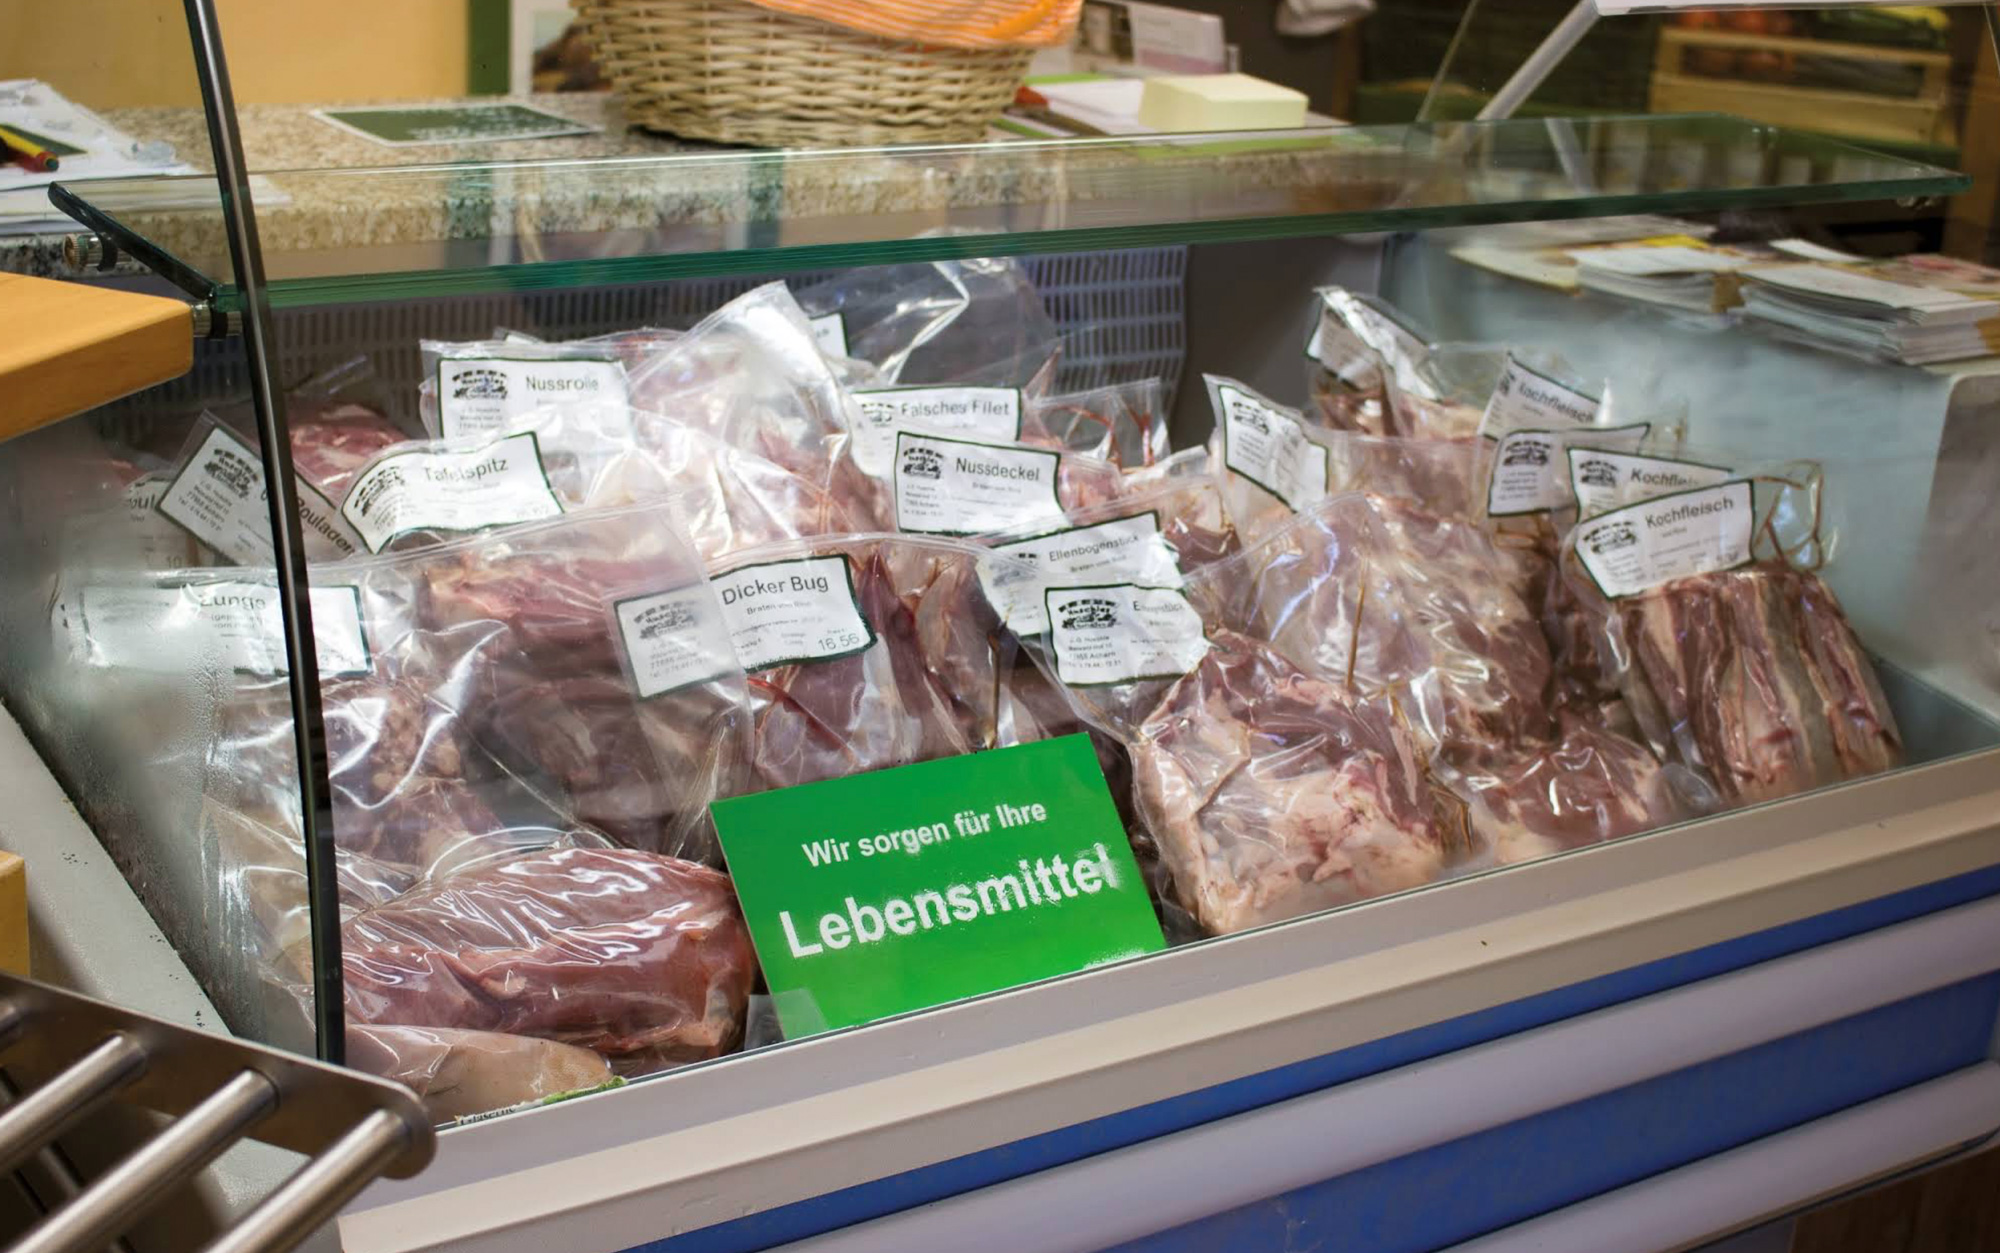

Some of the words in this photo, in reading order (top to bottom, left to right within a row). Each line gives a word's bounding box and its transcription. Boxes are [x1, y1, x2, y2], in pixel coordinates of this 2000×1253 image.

[526, 376, 599, 391] Nussrolle
[901, 401, 967, 417] Falsches
[971, 400, 1010, 416] Filet
[955, 457, 1040, 481] Nussdeckel
[1645, 496, 1734, 529] Kochfleisch
[721, 578, 786, 606] Dicker
[790, 576, 829, 593] Bug
[802, 840, 850, 867] Wir
[858, 820, 950, 857] sorgen
[953, 810, 993, 838] für
[996, 802, 1048, 830] Ihre
[779, 841, 1126, 959] Lebensmittel
